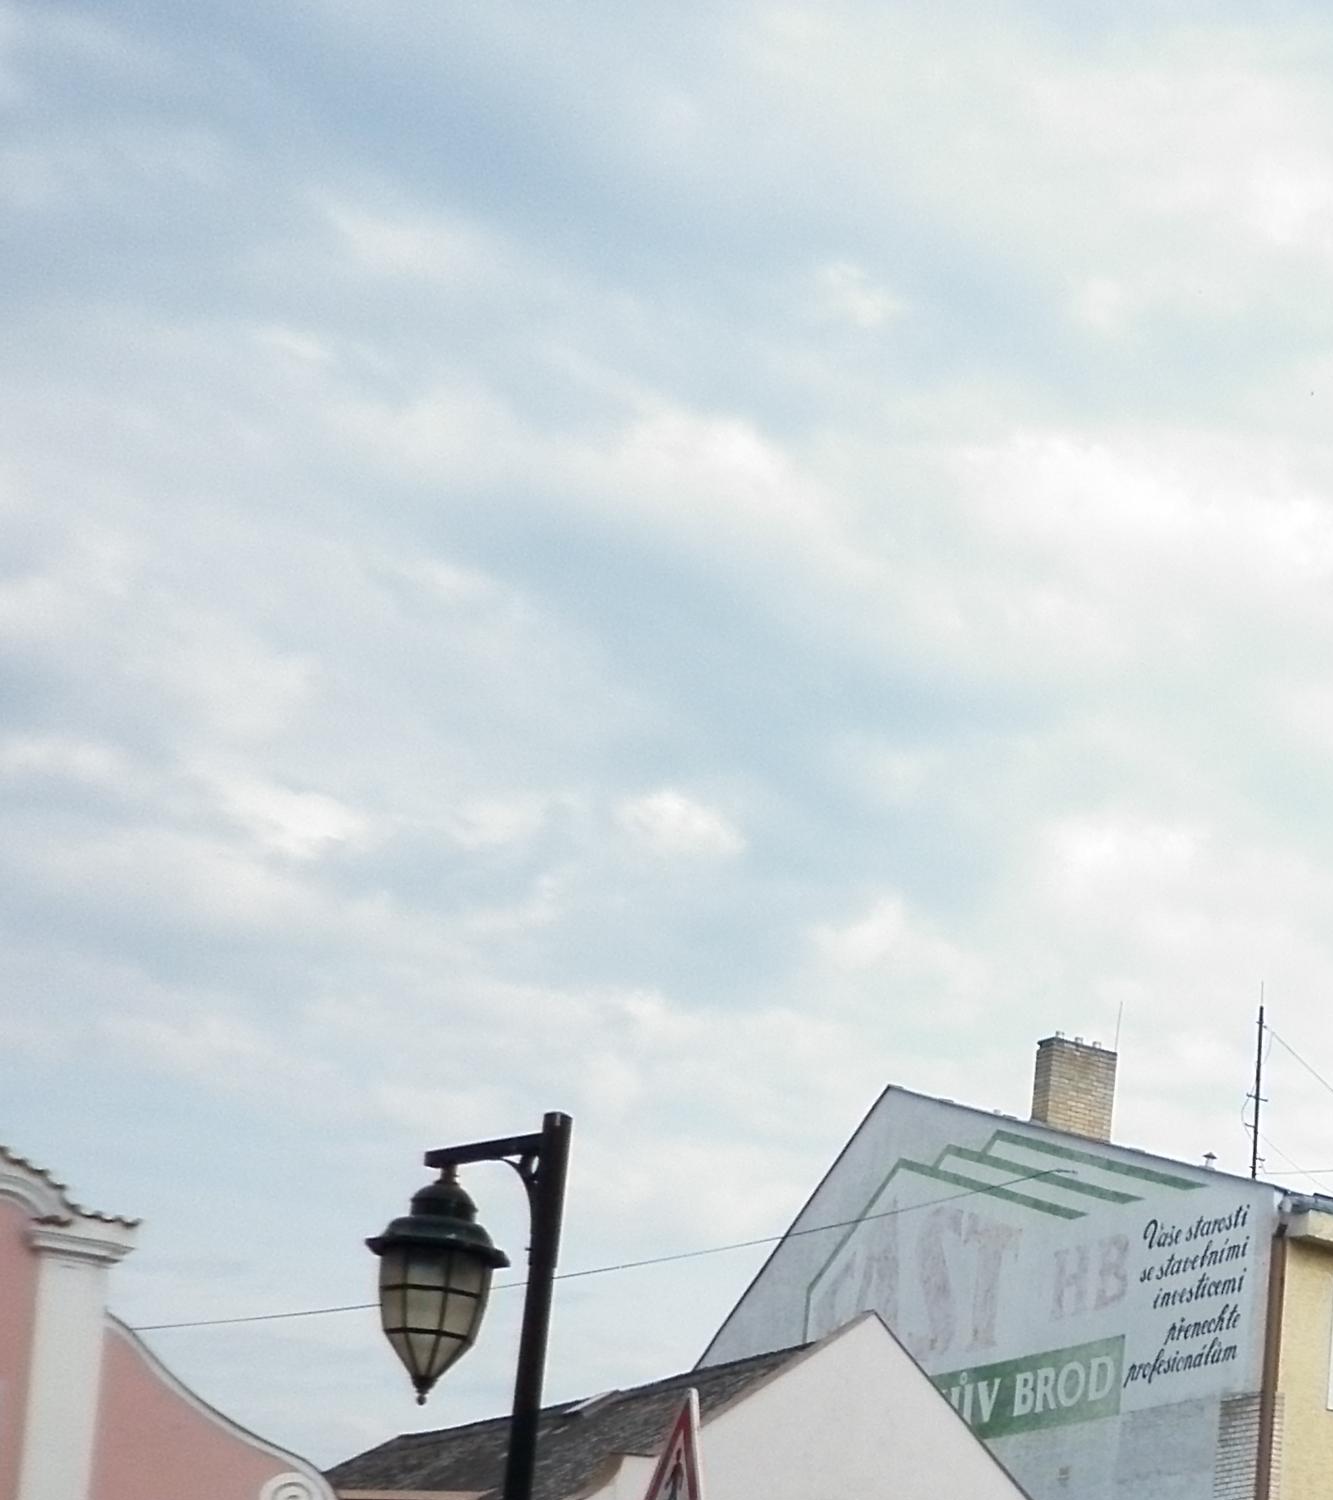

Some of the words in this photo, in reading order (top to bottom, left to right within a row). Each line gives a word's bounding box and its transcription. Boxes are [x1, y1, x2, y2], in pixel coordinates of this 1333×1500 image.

[1143, 1218, 1183, 1250] Vaše
[1185, 1204, 1250, 1242] starosti
[1139, 1264, 1154, 1283] se
[1156, 1236, 1250, 1281] stavebními
[1153, 1268, 1247, 1309] investicemi
[1164, 1303, 1241, 1345] přenechte
[1123, 1337, 1238, 1388] profesionálům
[1013, 1355, 1115, 1417] BROD
